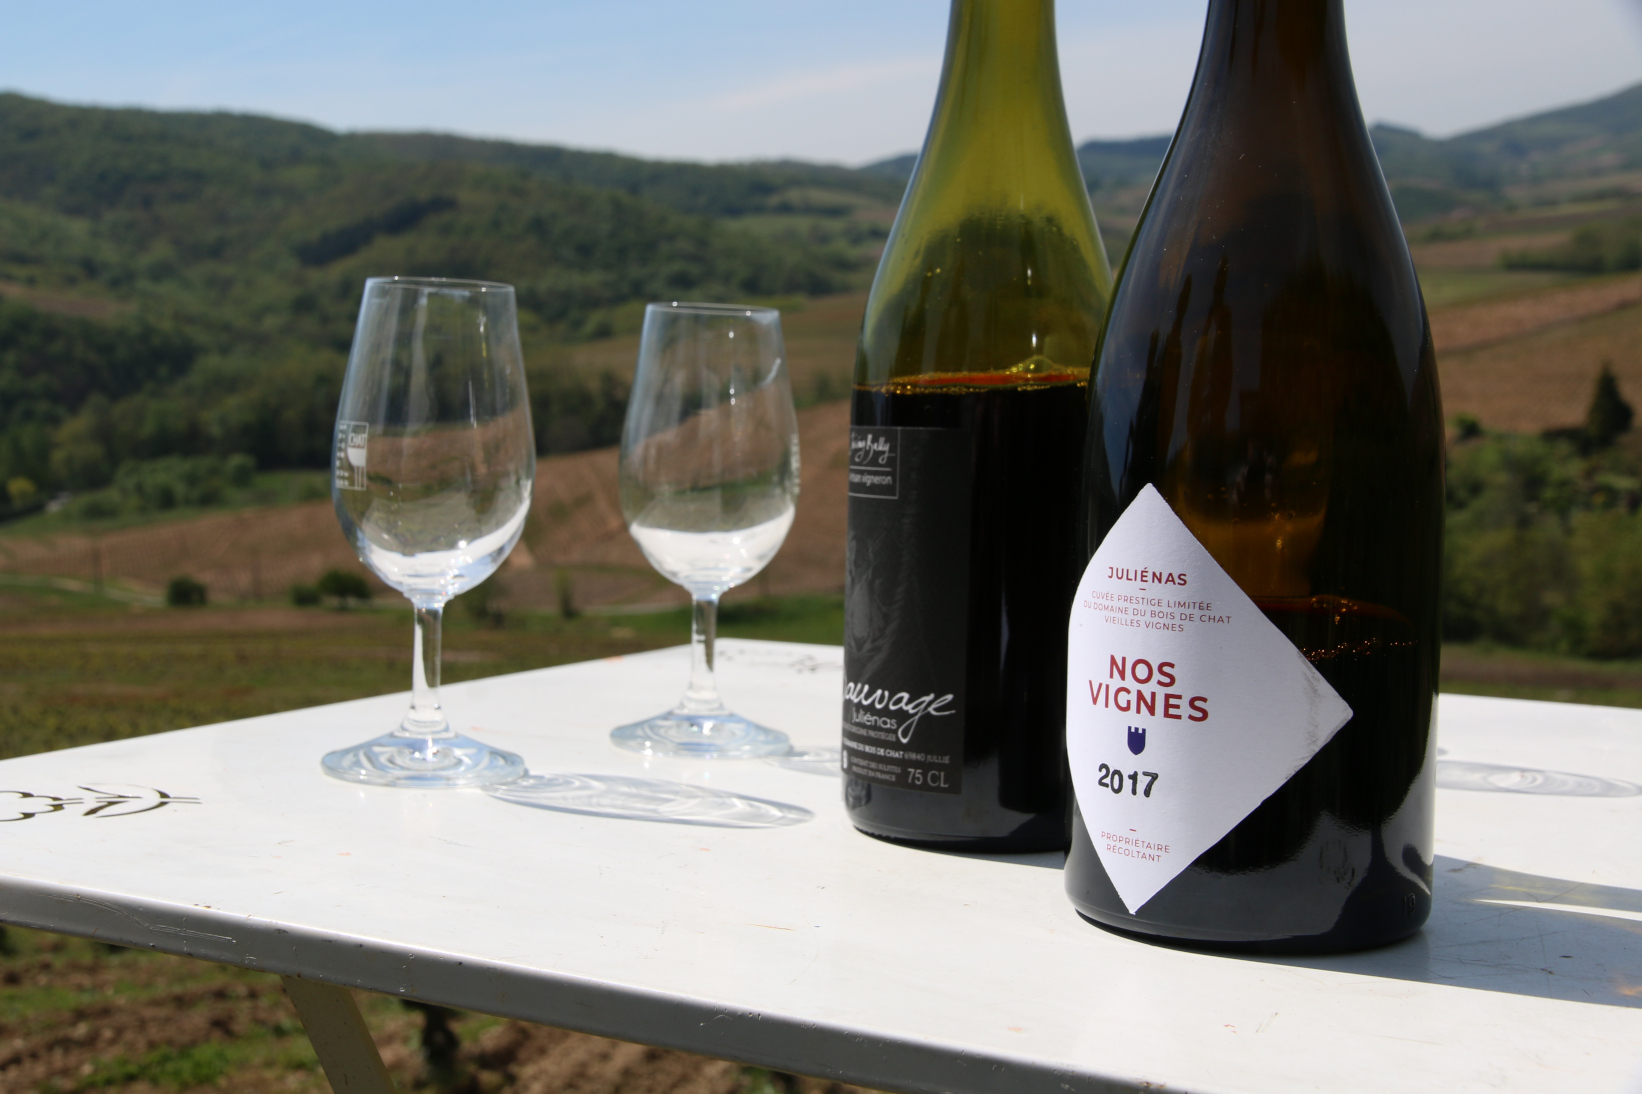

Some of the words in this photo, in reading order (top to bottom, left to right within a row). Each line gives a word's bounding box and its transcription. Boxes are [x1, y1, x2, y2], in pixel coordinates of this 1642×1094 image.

[1108, 566, 1187, 586] JULIÉNAS
[1091, 590, 1115, 602] CUVÉE
[1117, 594, 1163, 607] PRESTIGE
[1167, 599, 1213, 611] LIMITÉE
[1083, 600, 1092, 609] DU
[1093, 602, 1129, 615] DOMAINE
[1132, 608, 1146, 617] DU
[1150, 610, 1175, 620] BOIS
[1179, 612, 1195, 622] DE
[1199, 614, 1232, 624] CHAT
[1104, 615, 1141, 628] VIEILLES
[1144, 621, 1184, 632] VIGNES
[1109, 654, 1176, 688] NOS
[1088, 679, 1209, 723] VIGNES
[907, 768, 924, 785] 75
[927, 770, 949, 787] CL
[1097, 763, 1159, 798] 2017
[1101, 831, 1171, 854] PROPRIÉTAIRE
[1106, 844, 1162, 863] RÉCOLTANT
